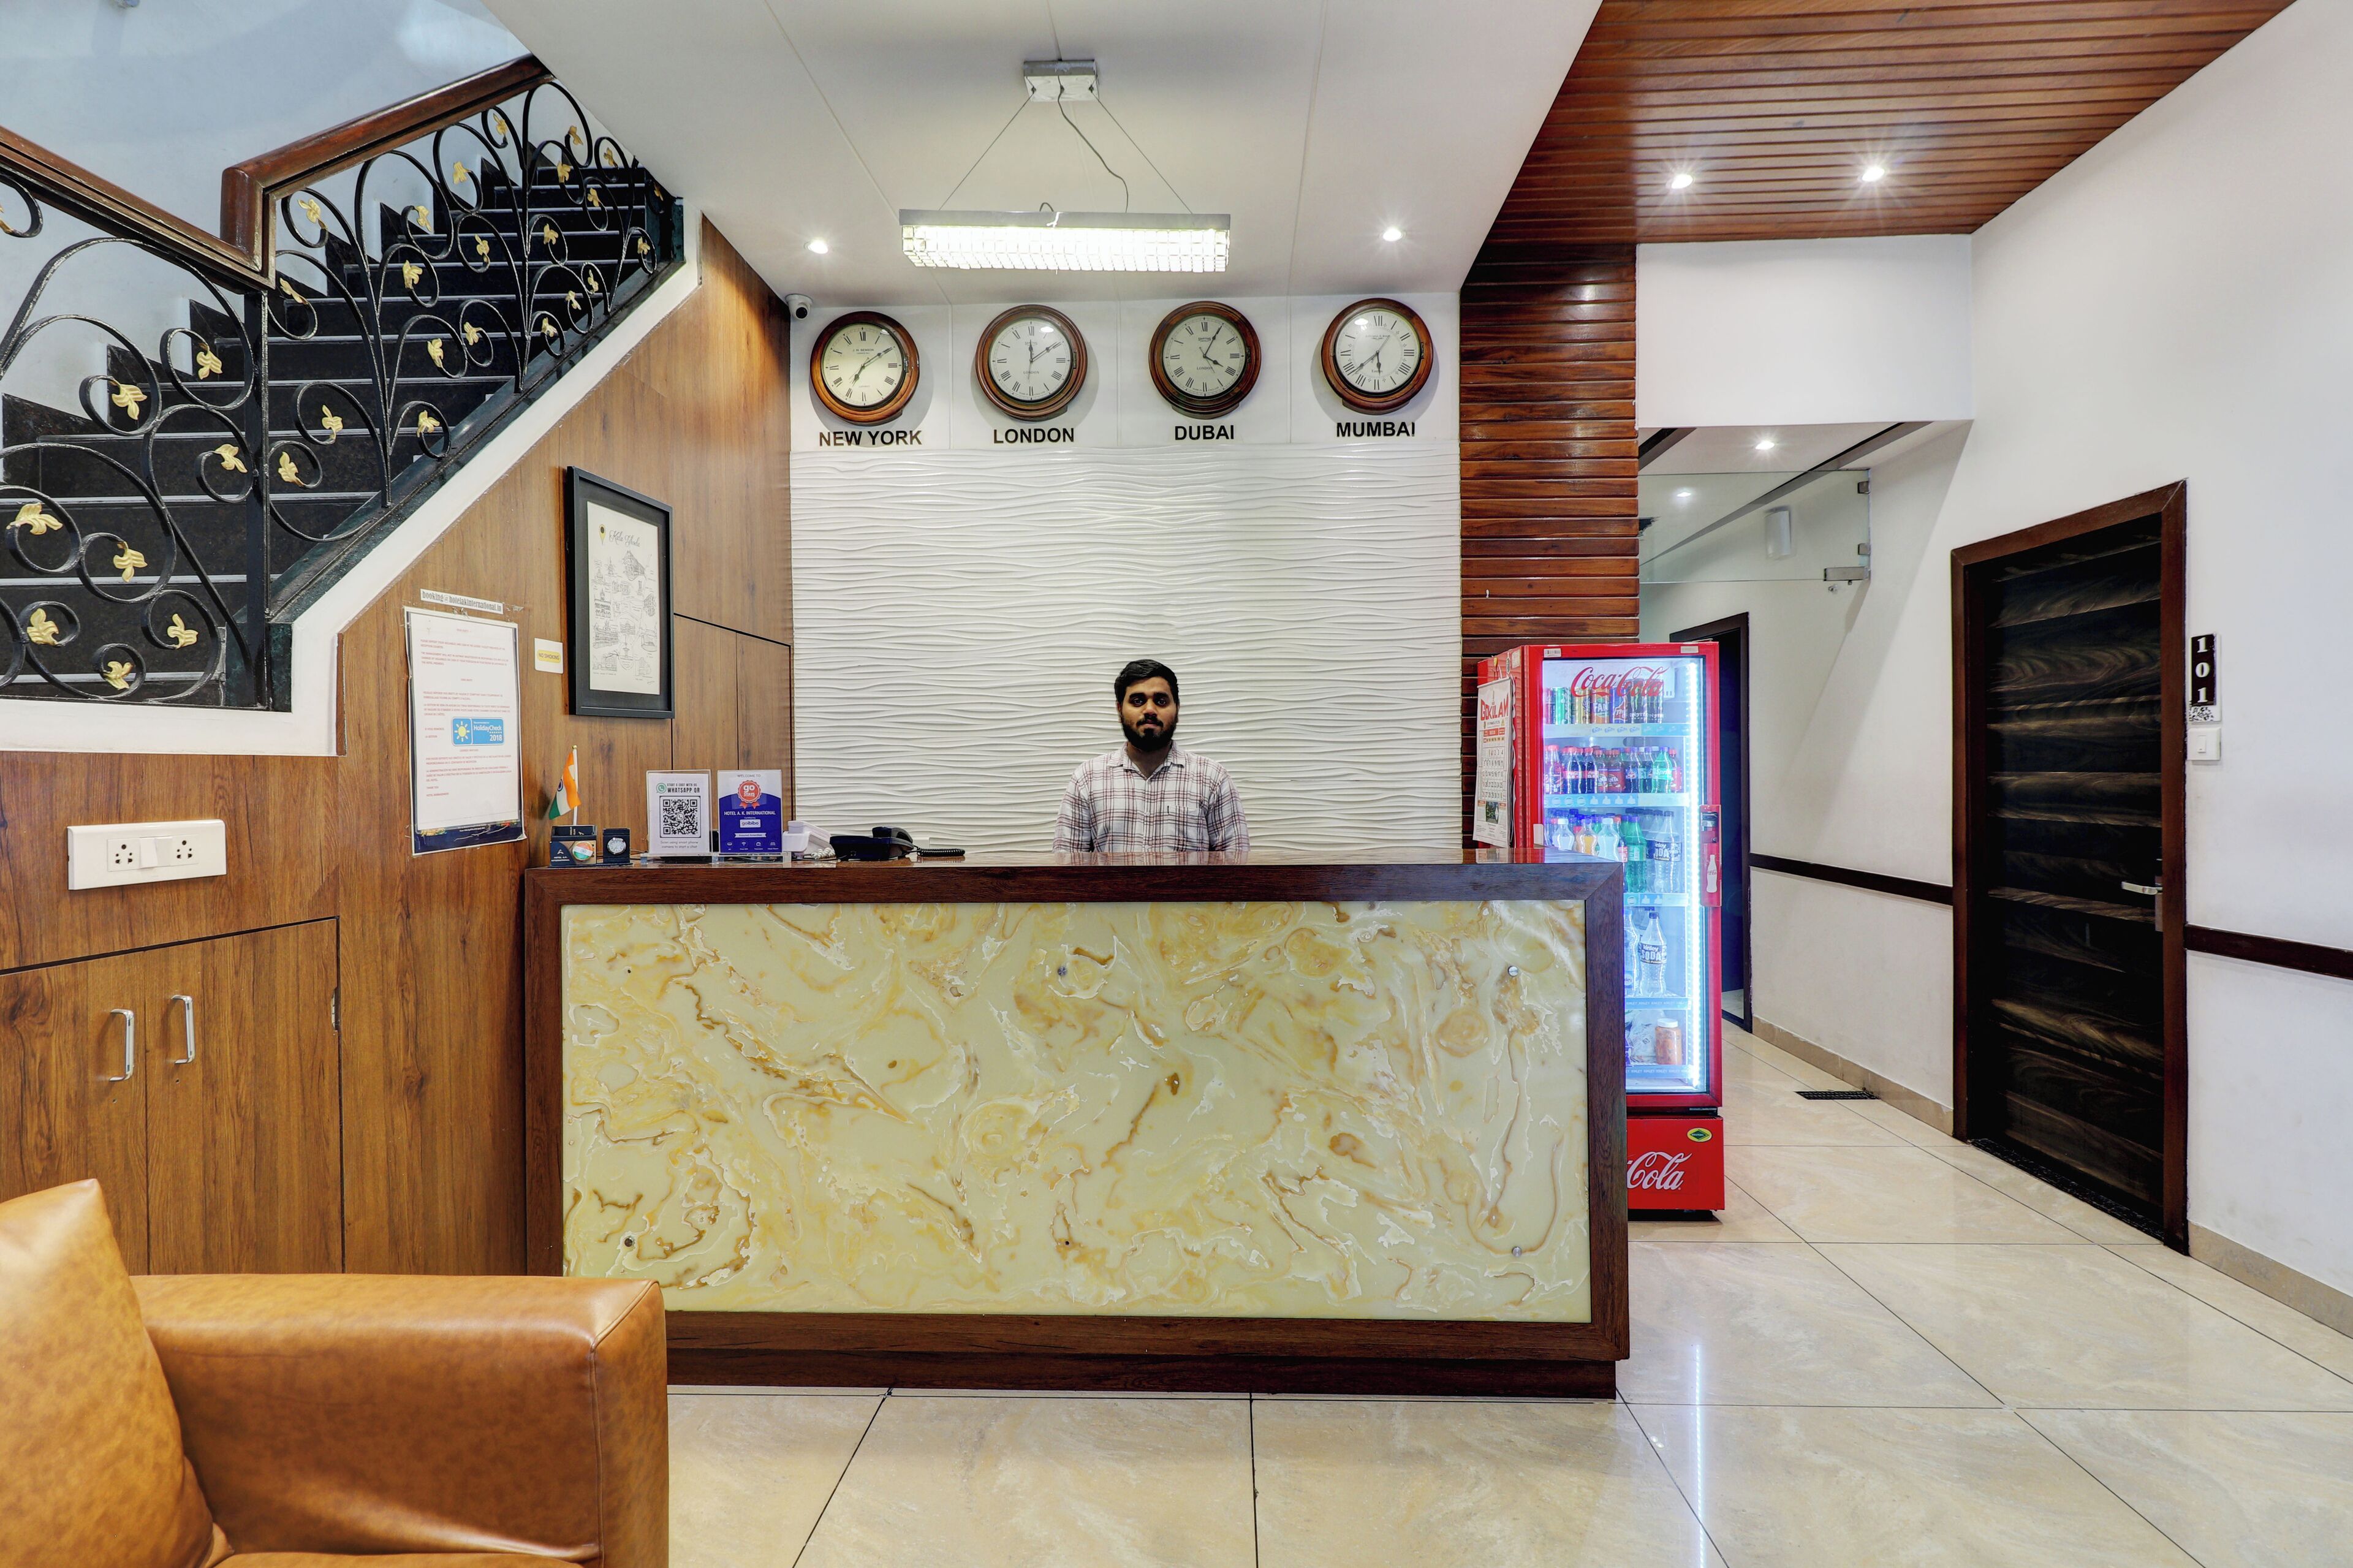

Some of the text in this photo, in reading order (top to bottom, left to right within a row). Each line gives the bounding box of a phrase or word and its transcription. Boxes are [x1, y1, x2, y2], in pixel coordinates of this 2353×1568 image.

[993, 428, 1075, 444] LONDON
[1175, 425, 1234, 440] DUBAI
[1336, 422, 1415, 437] MUMBAI
[819, 430, 922, 447] NEW YORK
[1571, 667, 1669, 697] Coca-Cola
[1641, 949, 1662, 961] SODA
